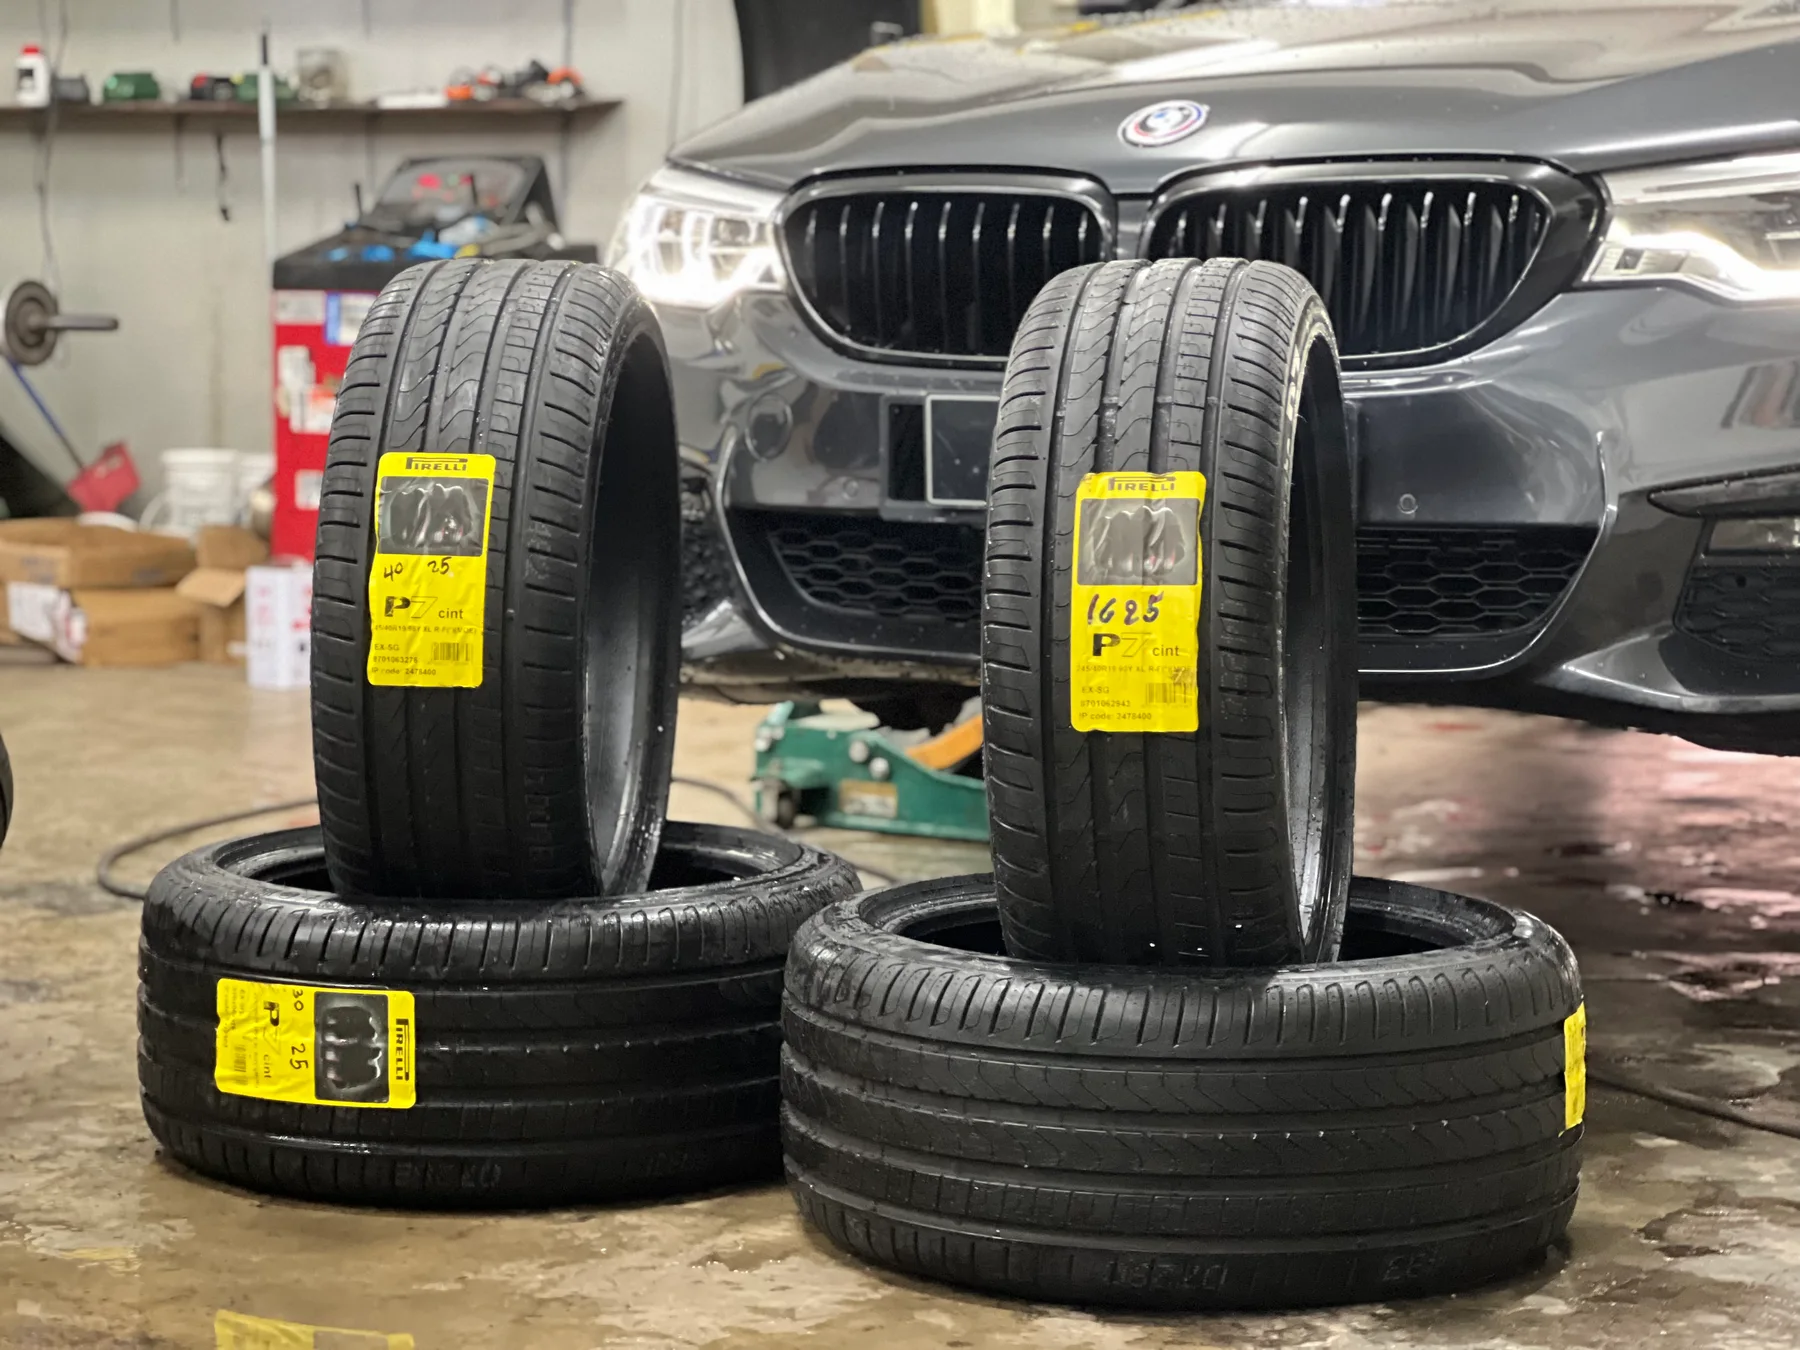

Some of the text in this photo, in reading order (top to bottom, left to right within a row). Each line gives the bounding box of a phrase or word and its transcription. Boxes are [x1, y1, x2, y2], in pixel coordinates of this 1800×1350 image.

[405, 456, 468, 471] PIRELLI
[1107, 476, 1176, 491] PIRELLI
[383, 556, 452, 581] 40 25
[438, 607, 464, 619] cint
[1152, 645, 1180, 657] cint
[289, 1043, 309, 1070] 25
[396, 1018, 410, 1081] PIRELLI
